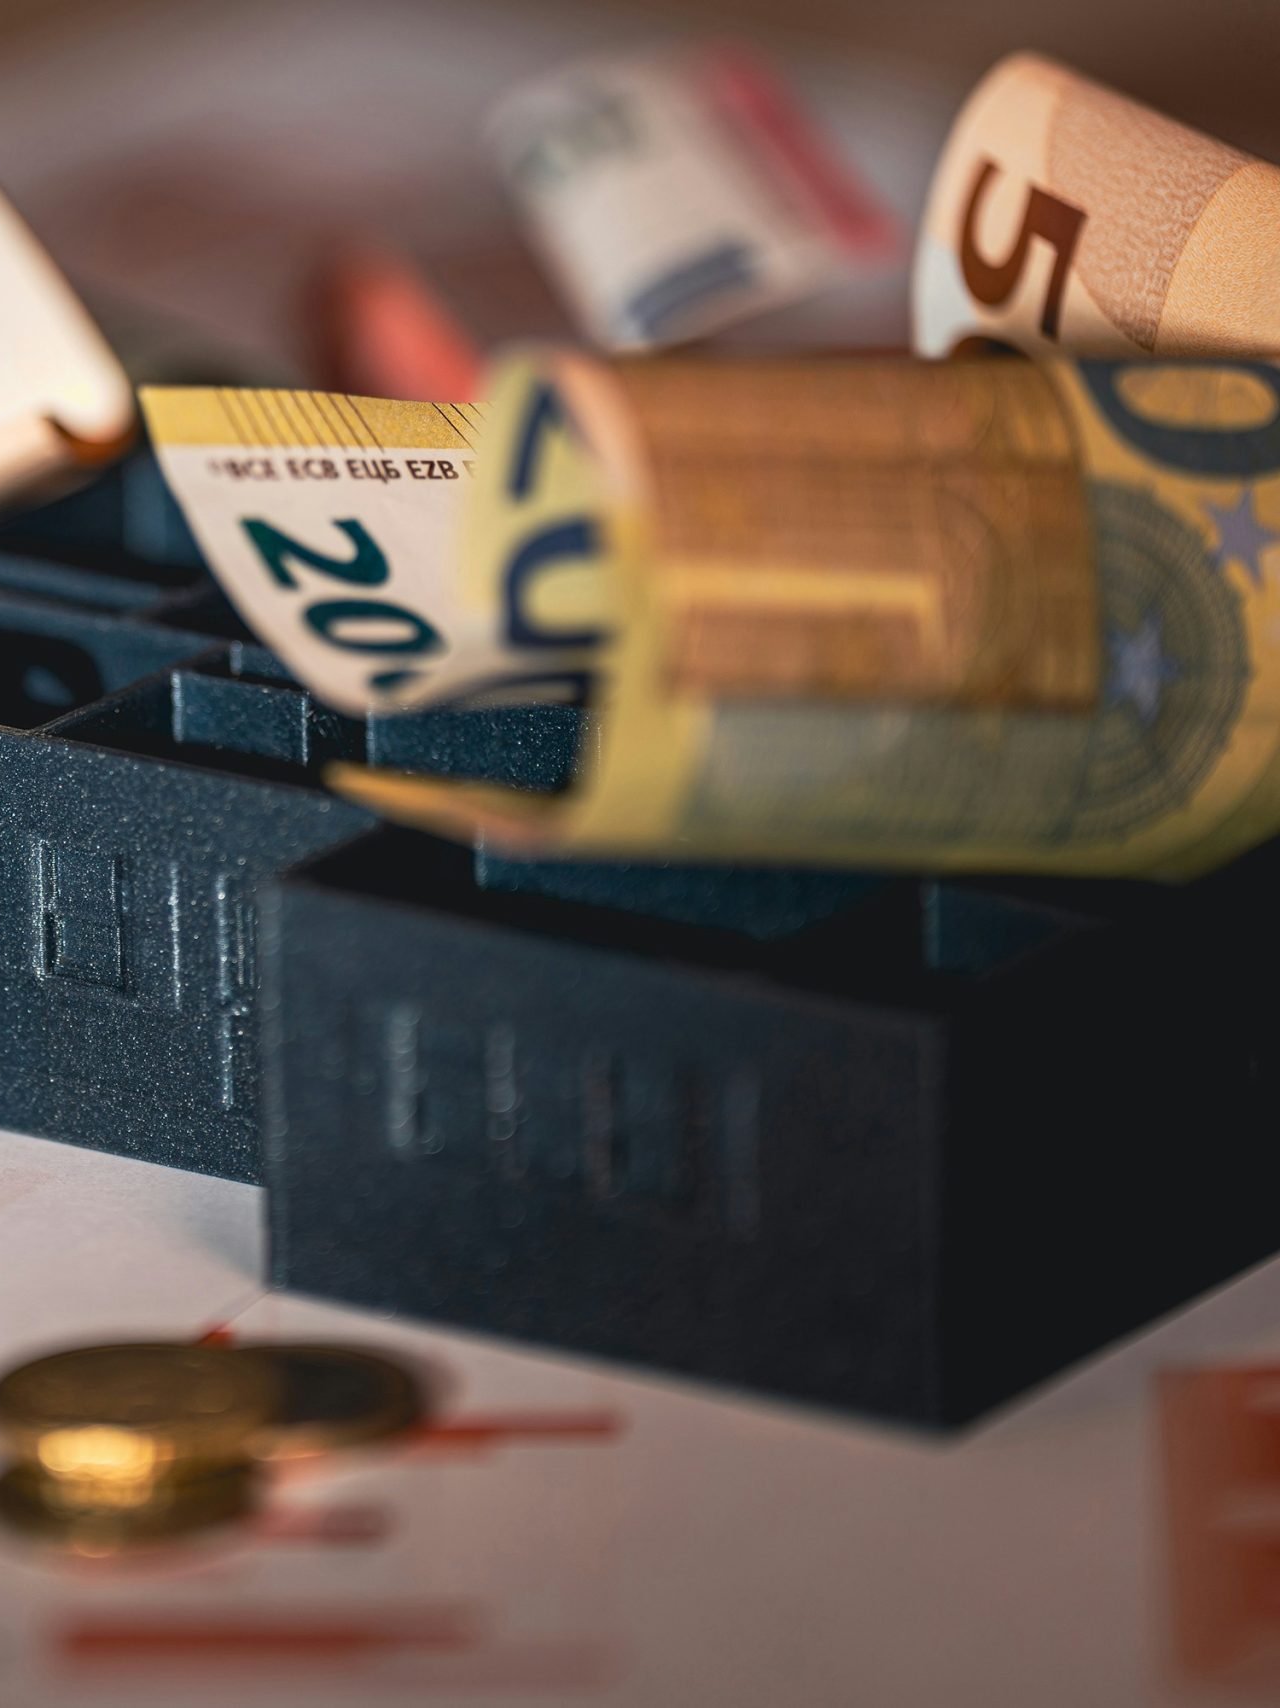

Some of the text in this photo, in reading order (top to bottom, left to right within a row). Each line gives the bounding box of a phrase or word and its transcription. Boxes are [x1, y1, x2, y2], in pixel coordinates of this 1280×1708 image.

[284, 459, 341, 480] ECB
[405, 459, 460, 480] EZB
[237, 516, 448, 694] 20
